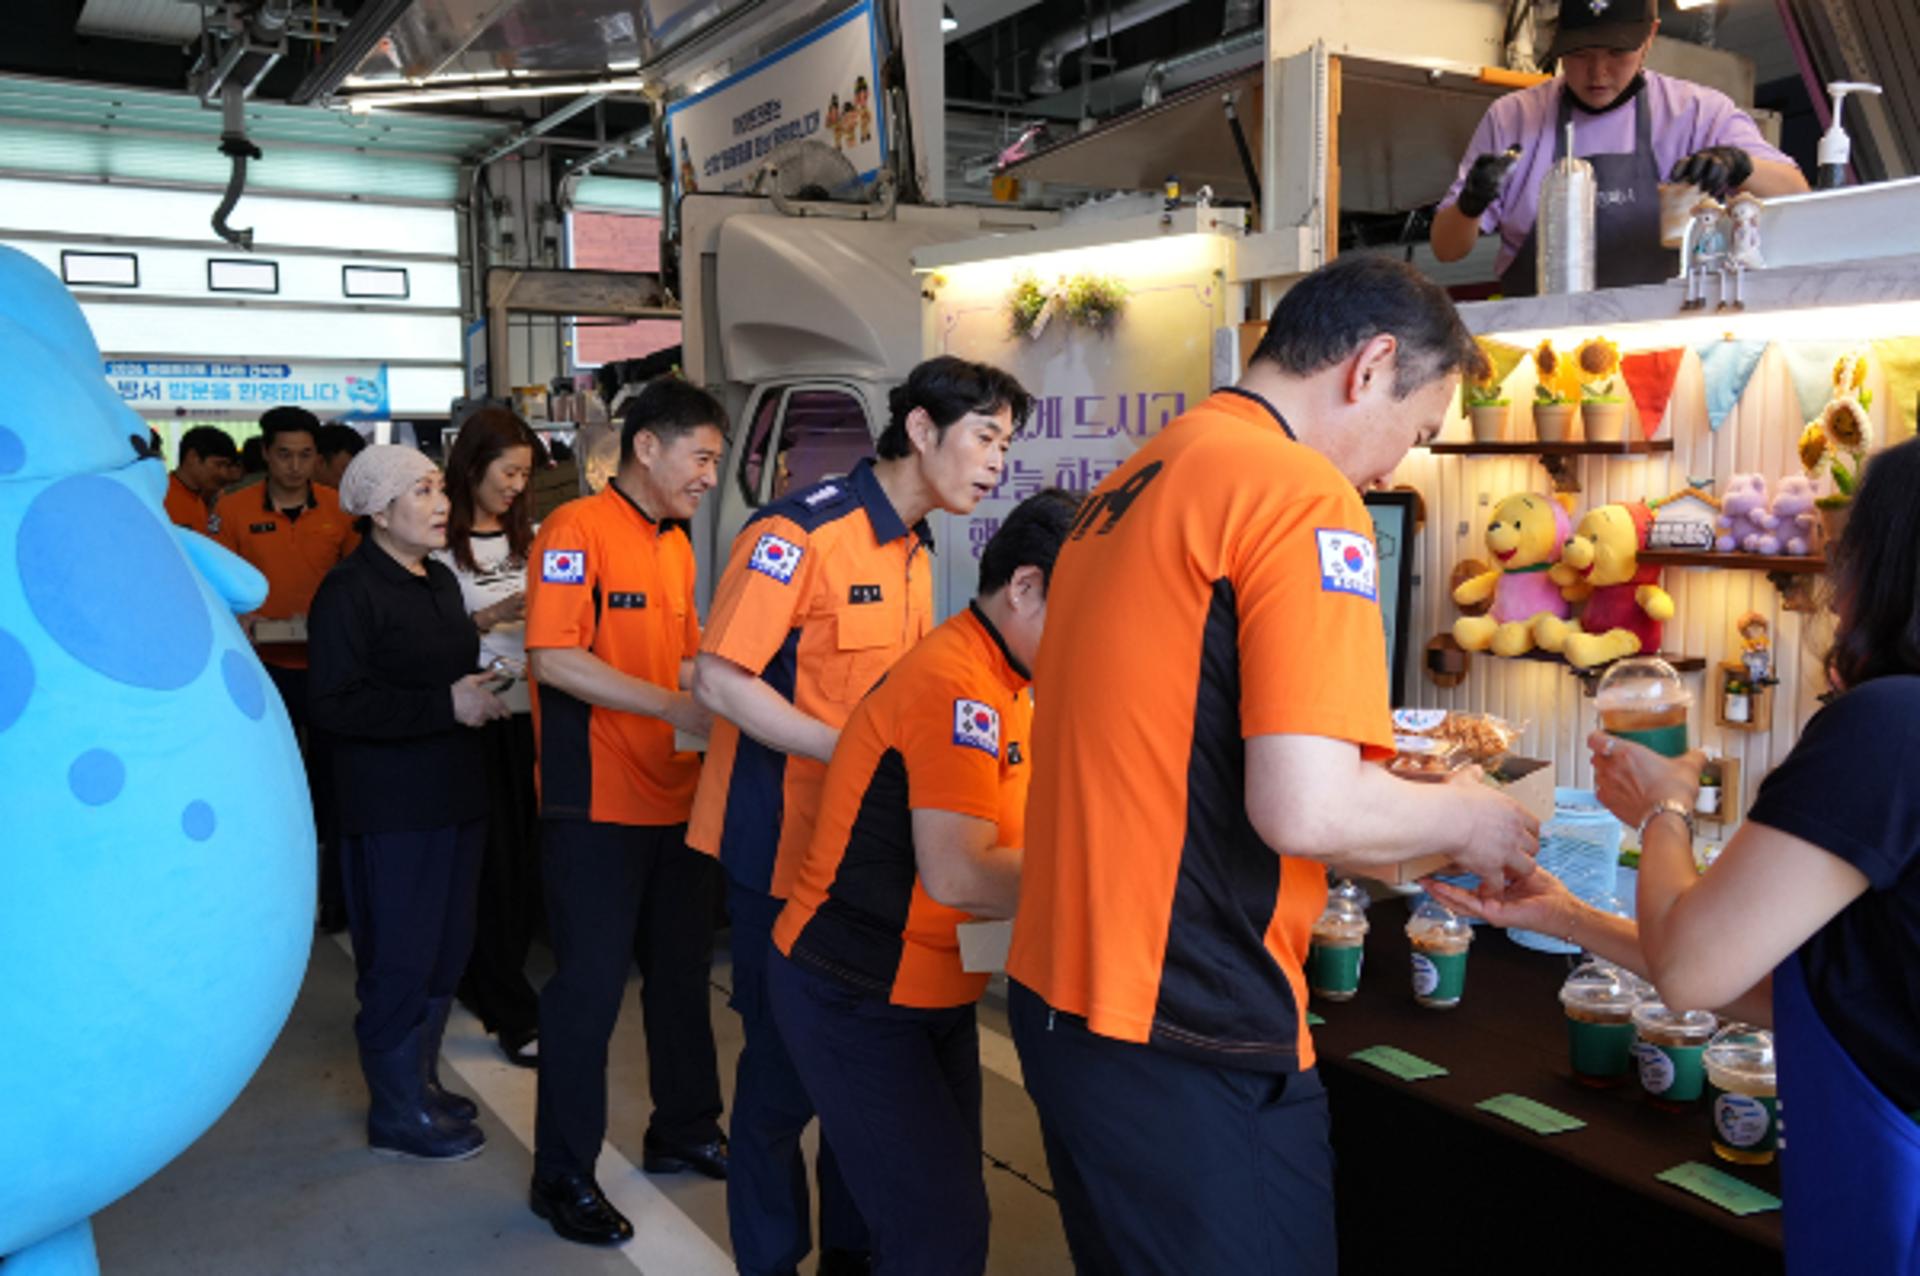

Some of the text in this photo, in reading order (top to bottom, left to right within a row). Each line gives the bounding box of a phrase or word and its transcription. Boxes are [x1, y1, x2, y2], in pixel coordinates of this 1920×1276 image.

[168, 382, 231, 401] 방문을
[238, 383, 341, 401] 환영합니다
[1072, 393, 1185, 439] 드시고
